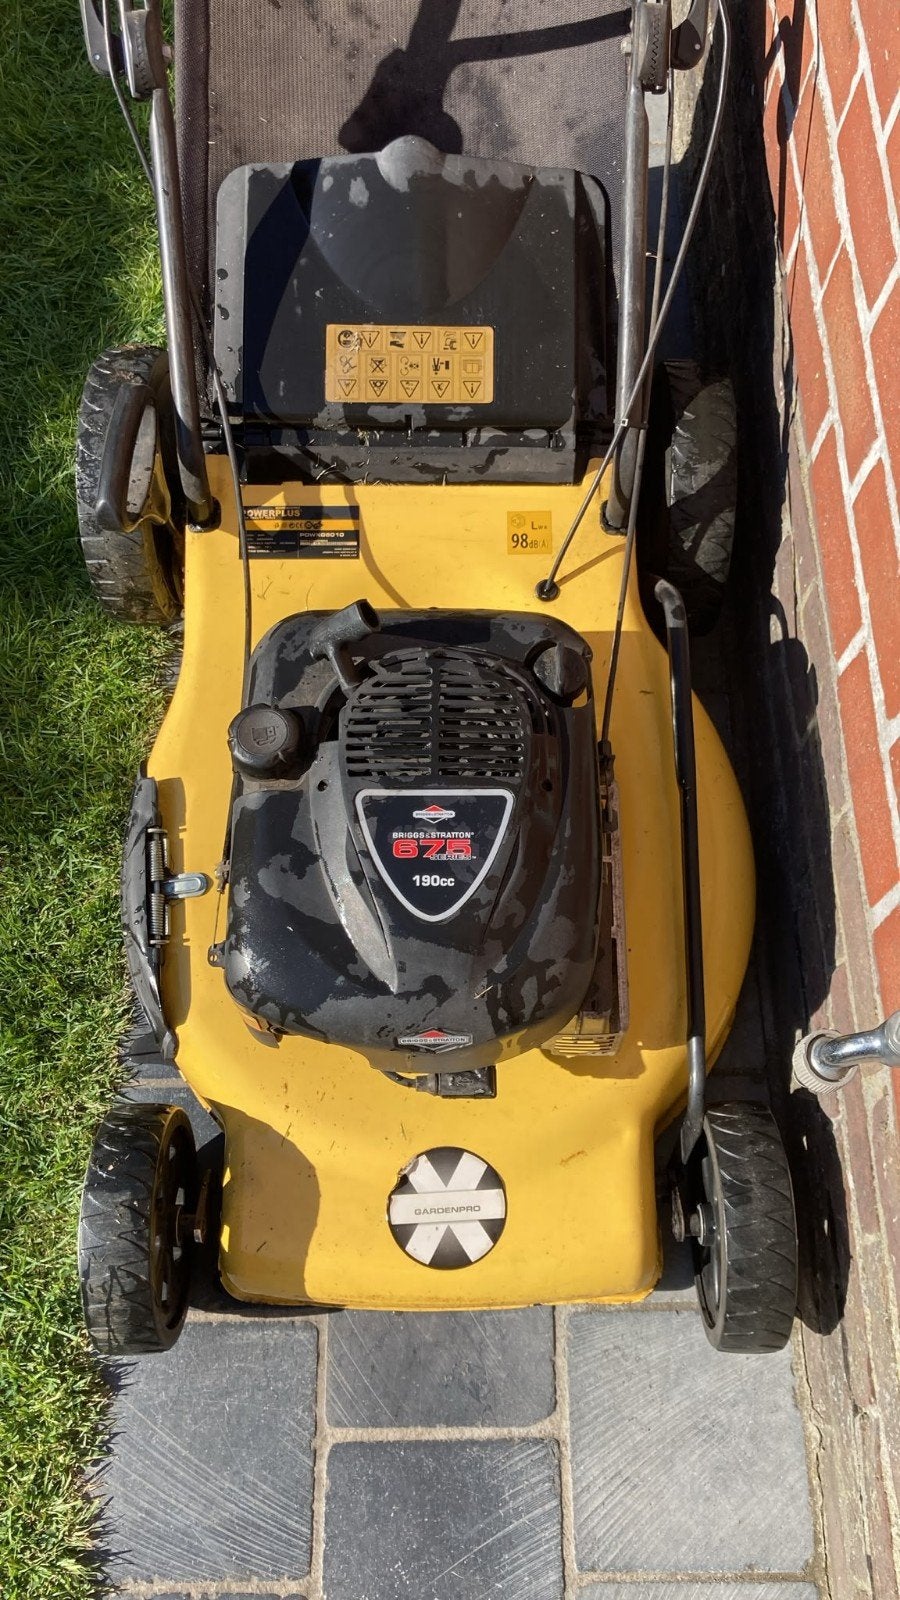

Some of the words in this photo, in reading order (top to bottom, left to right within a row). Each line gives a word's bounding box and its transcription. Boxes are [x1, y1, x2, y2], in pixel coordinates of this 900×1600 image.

[243, 509, 301, 517] OWERPLUS
[392, 839, 472, 859] 675
[412, 874, 455, 887] 190cc
[414, 1205, 481, 1216] GARDENPRO
